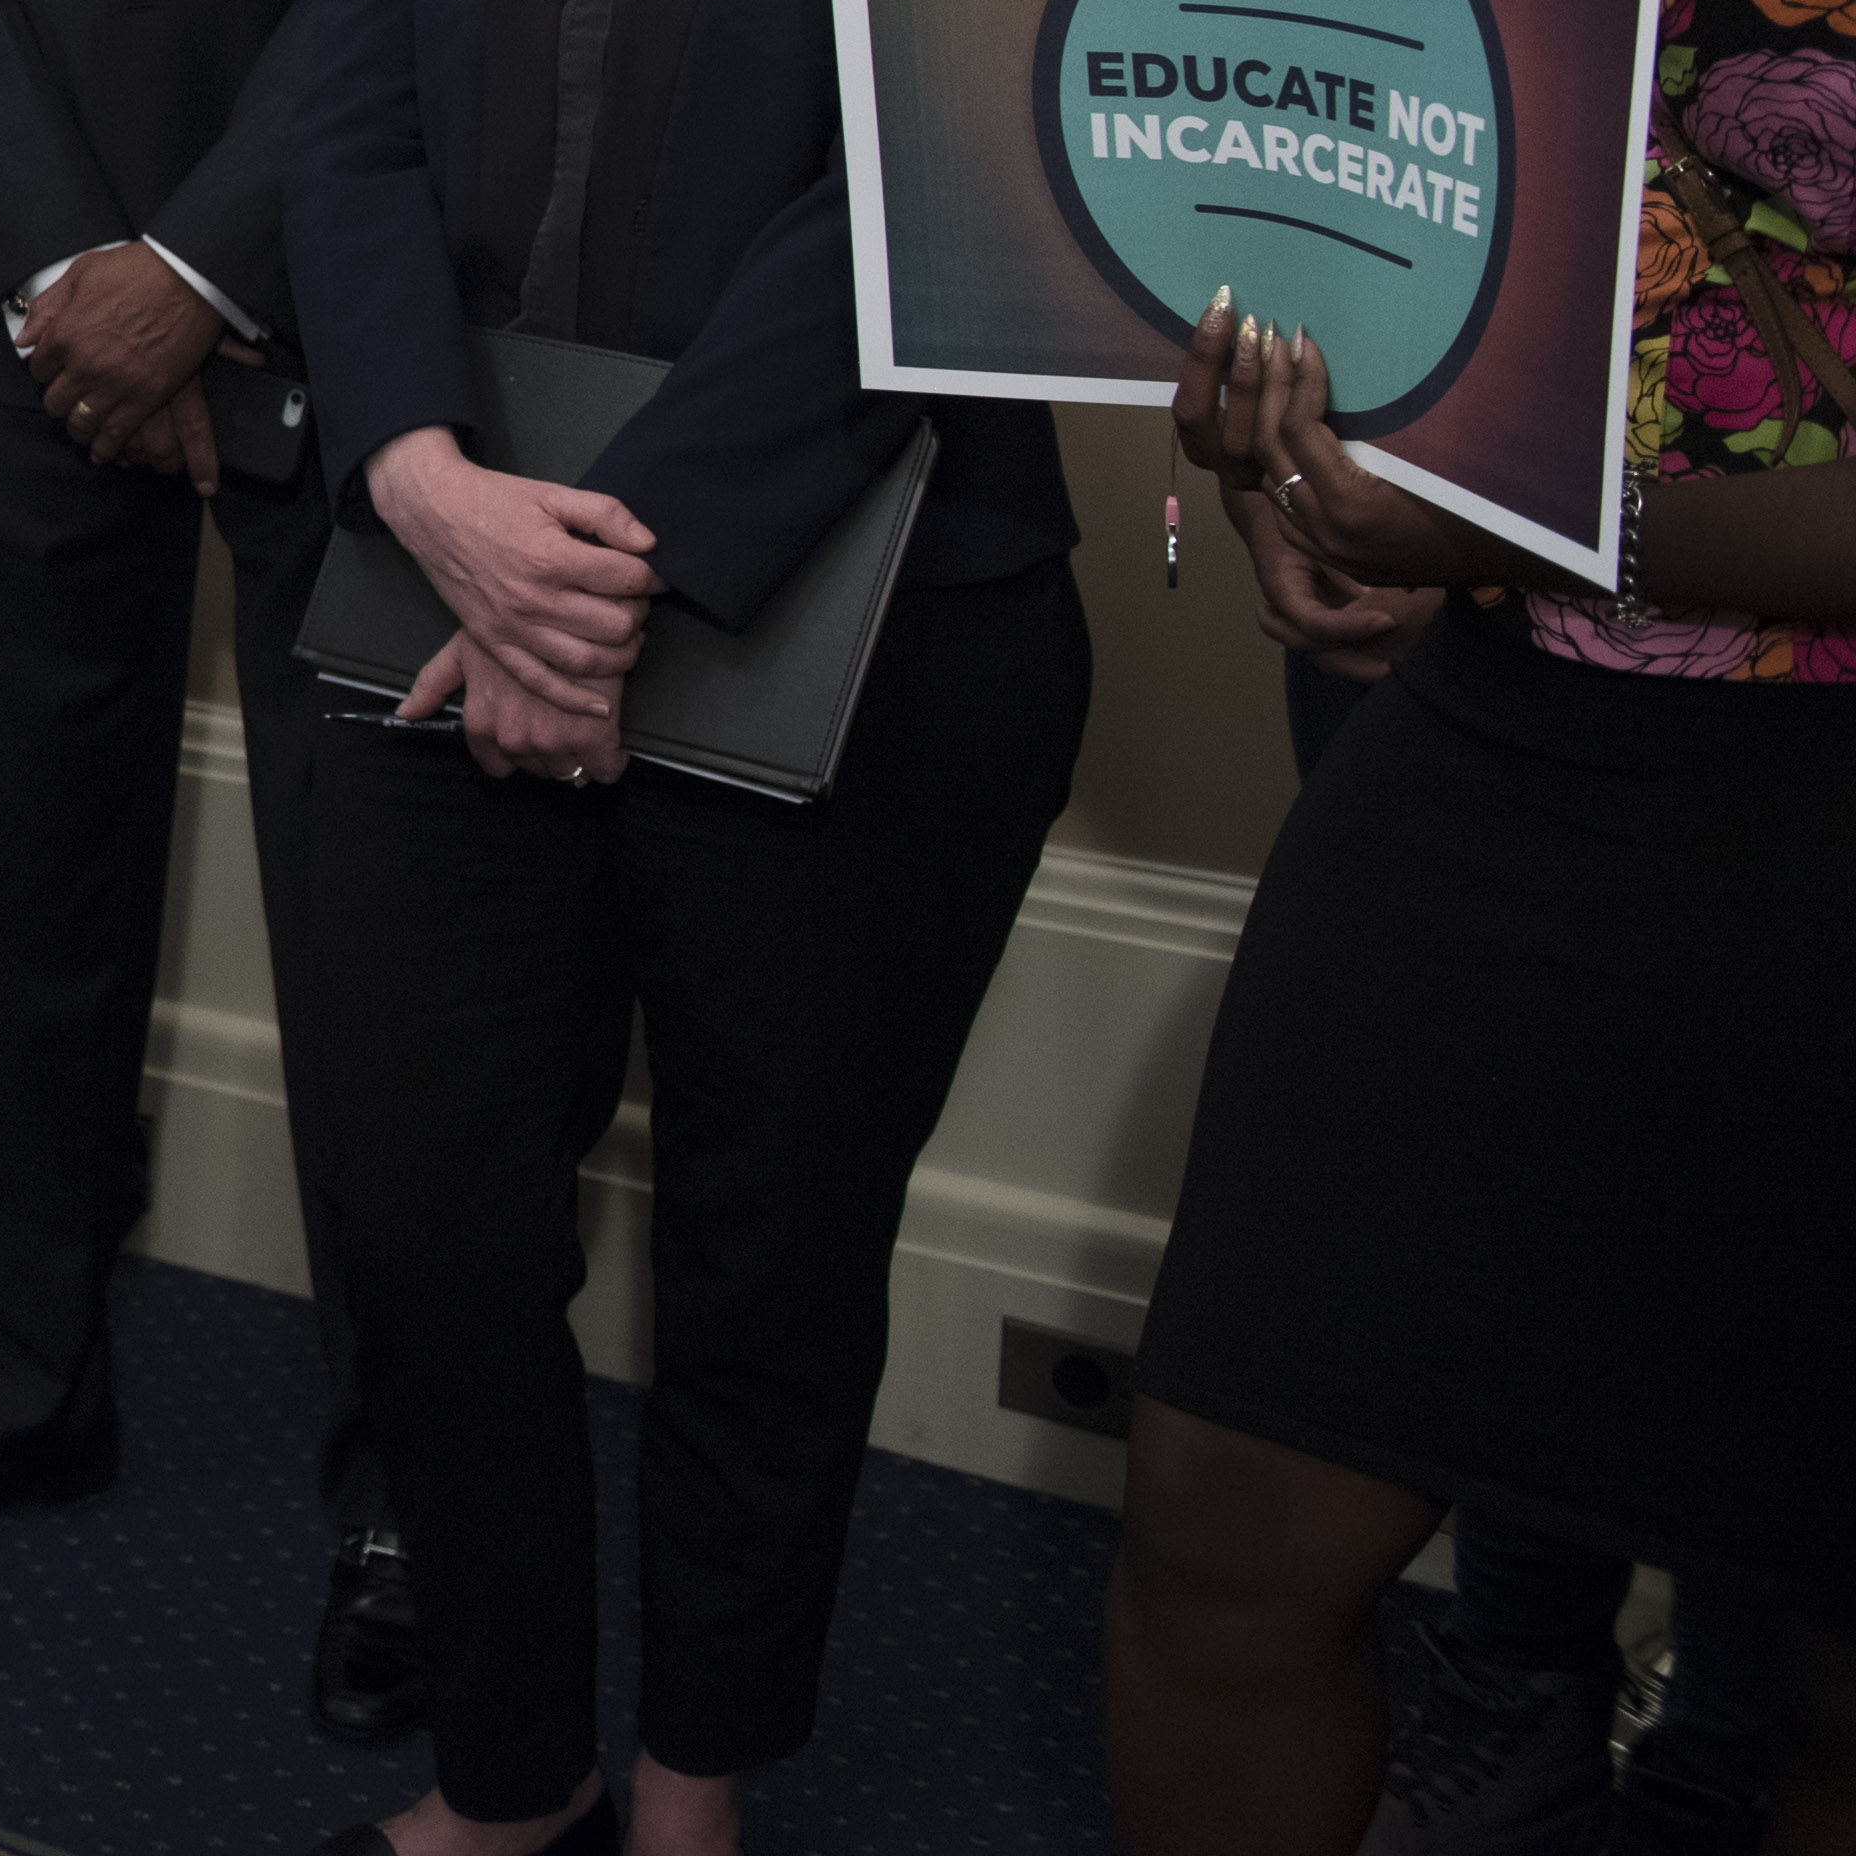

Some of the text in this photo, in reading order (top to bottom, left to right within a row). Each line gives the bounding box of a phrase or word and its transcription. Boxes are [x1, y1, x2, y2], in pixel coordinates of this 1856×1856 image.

[1087, 50, 1485, 169] EDUCATE NOT
[1090, 112, 1481, 238] INCARCERATE
